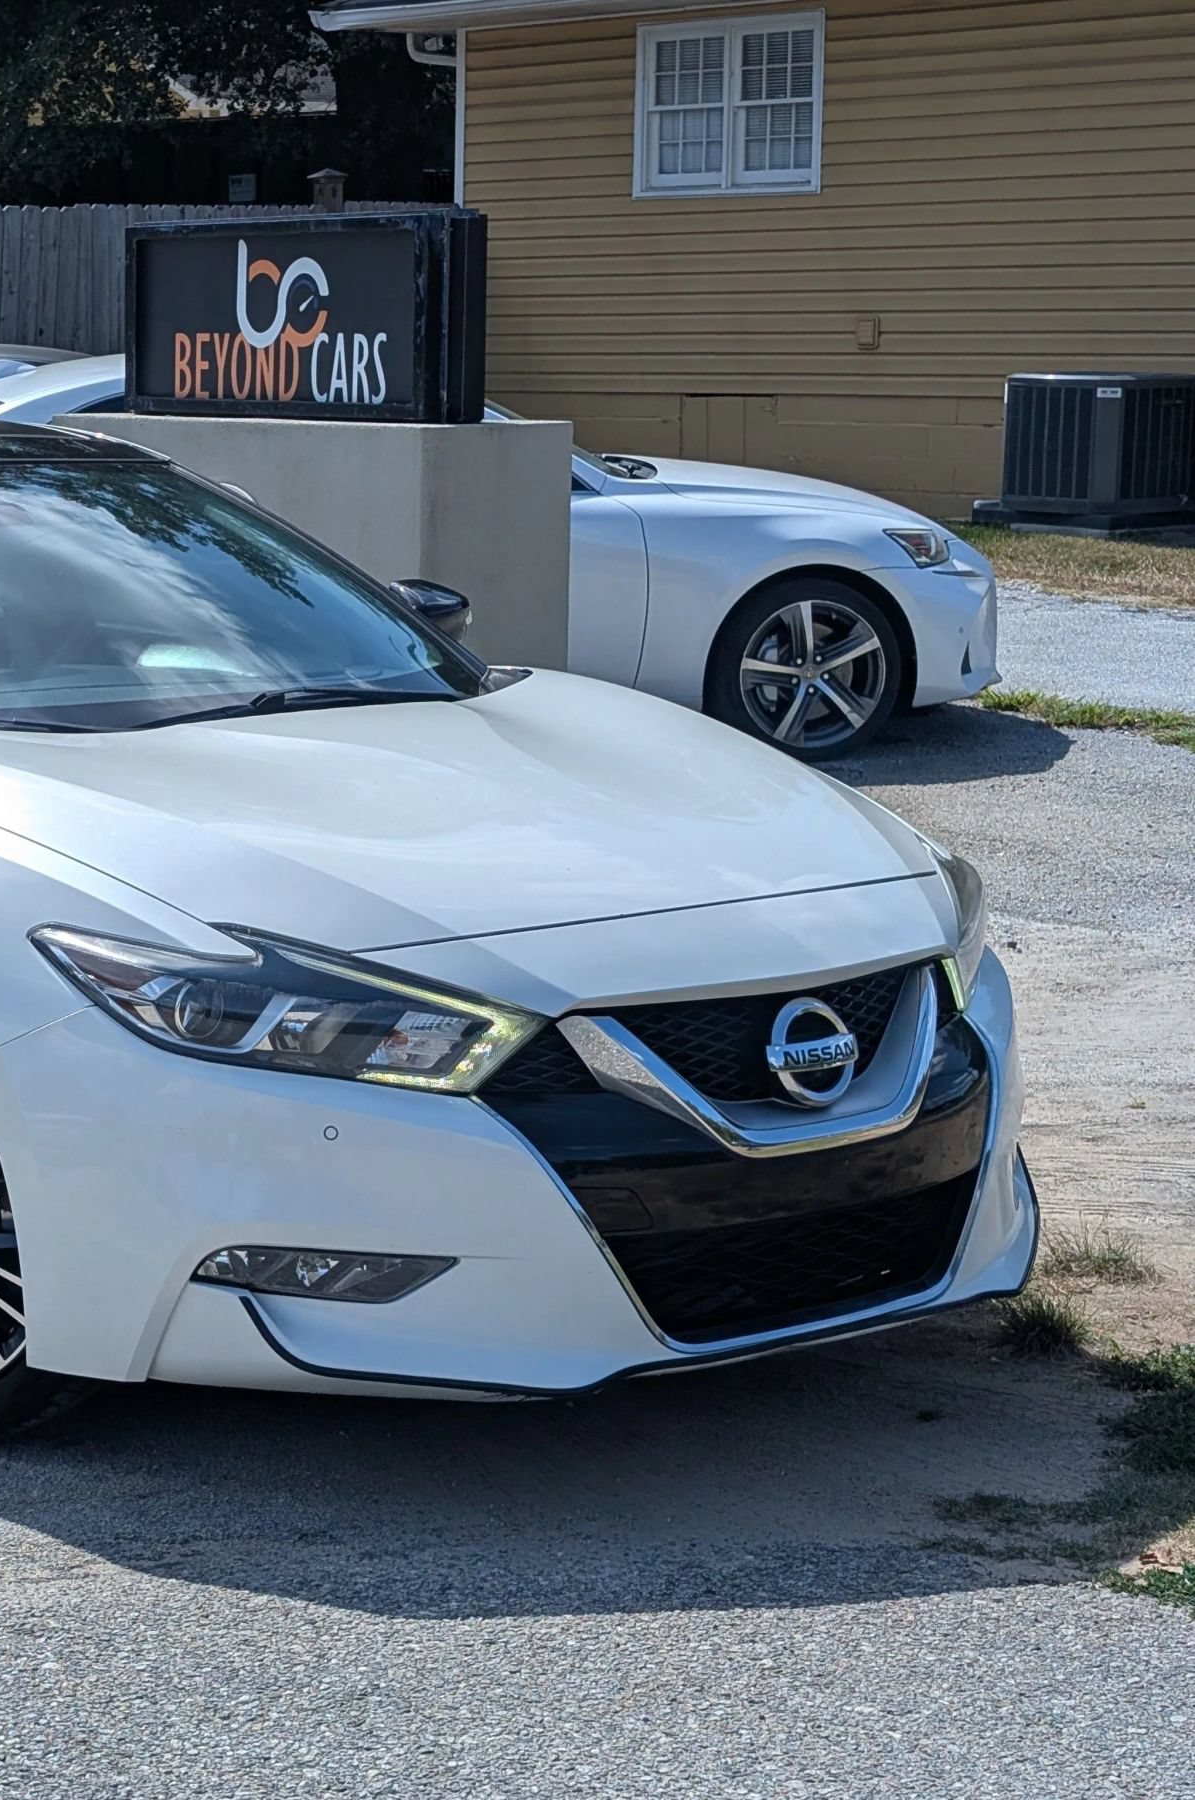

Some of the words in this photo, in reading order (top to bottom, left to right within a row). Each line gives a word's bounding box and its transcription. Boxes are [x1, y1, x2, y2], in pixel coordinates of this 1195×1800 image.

[174, 332, 300, 399] BEYOND
[311, 332, 387, 404] CARS
[783, 1040, 855, 1067] NISSAN
